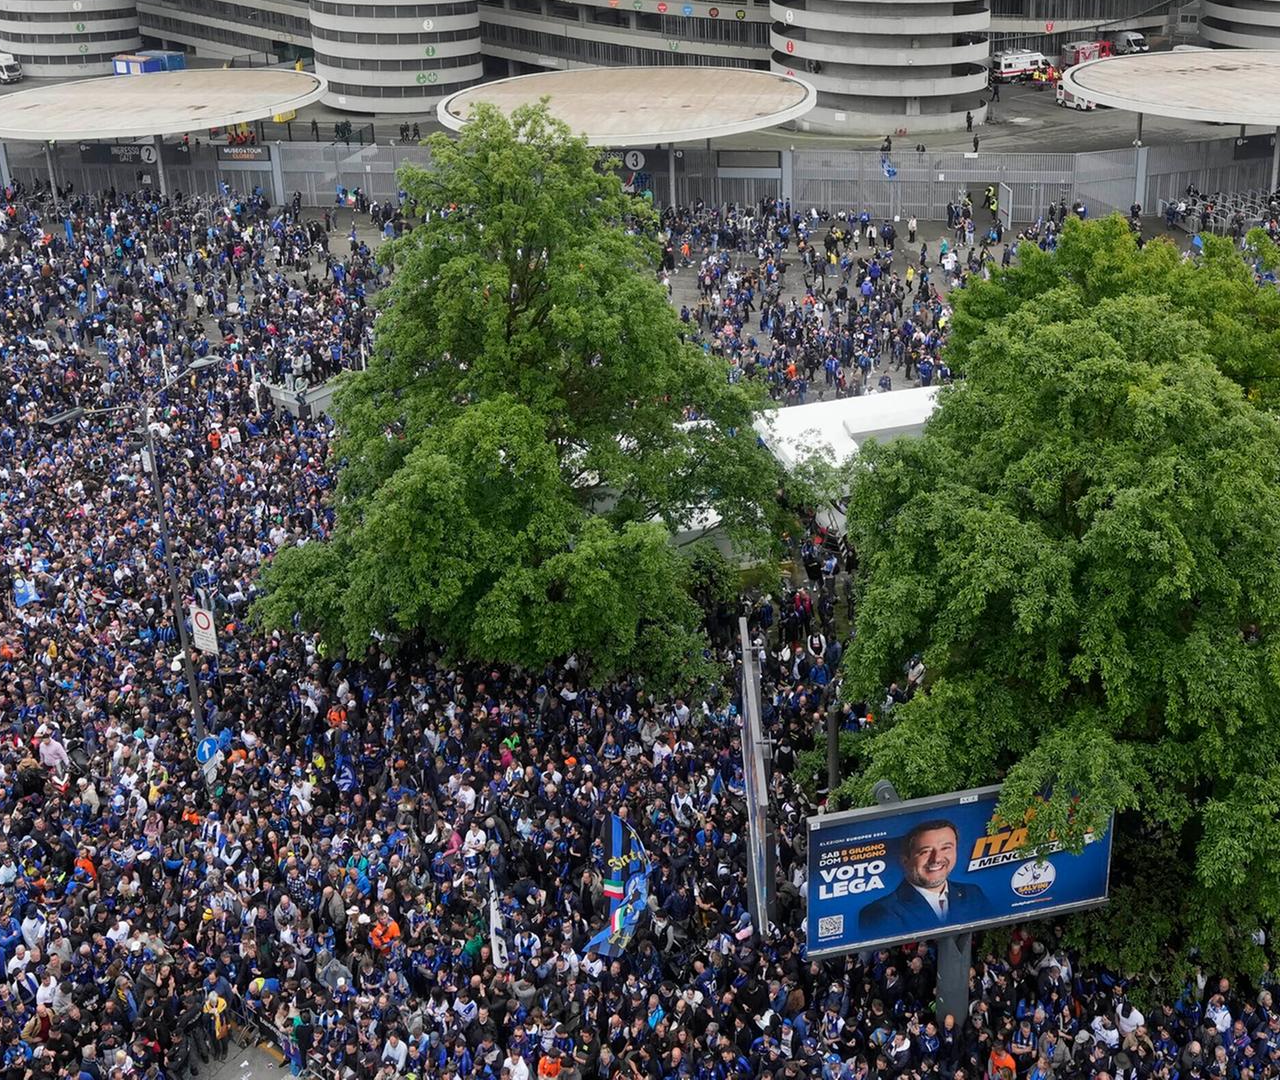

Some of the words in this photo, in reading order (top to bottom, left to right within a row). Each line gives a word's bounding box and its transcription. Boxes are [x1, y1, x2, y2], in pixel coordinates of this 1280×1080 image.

[819, 857, 841, 867] DOM
[842, 855, 849, 863] 9
[849, 849, 887, 862] GIUGNO
[821, 850, 840, 860] SAB
[848, 843, 886, 856] GIUGNO
[819, 859, 886, 883] VOTO
[819, 875, 886, 900] LEGA
[1018, 881, 1049, 893] SALVINI
